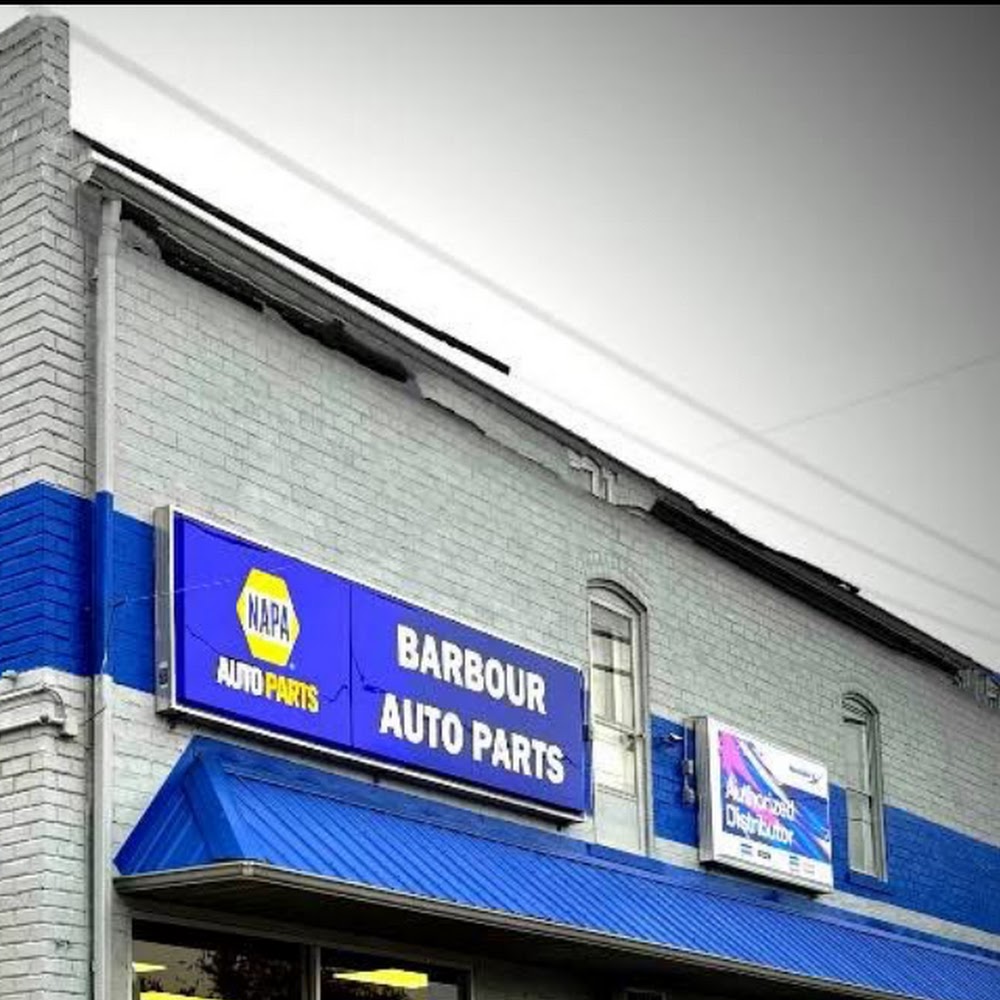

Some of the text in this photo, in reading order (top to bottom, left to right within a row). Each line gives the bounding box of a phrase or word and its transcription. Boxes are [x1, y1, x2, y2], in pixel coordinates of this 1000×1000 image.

[247, 592, 290, 642] NAPA
[217, 655, 319, 713] AUTO PARTS
[396, 623, 547, 715] BARBOUR
[379, 692, 565, 785] AUTO PARTS
[725, 772, 795, 820] Authorized
[726, 803, 794, 846] Distributor
